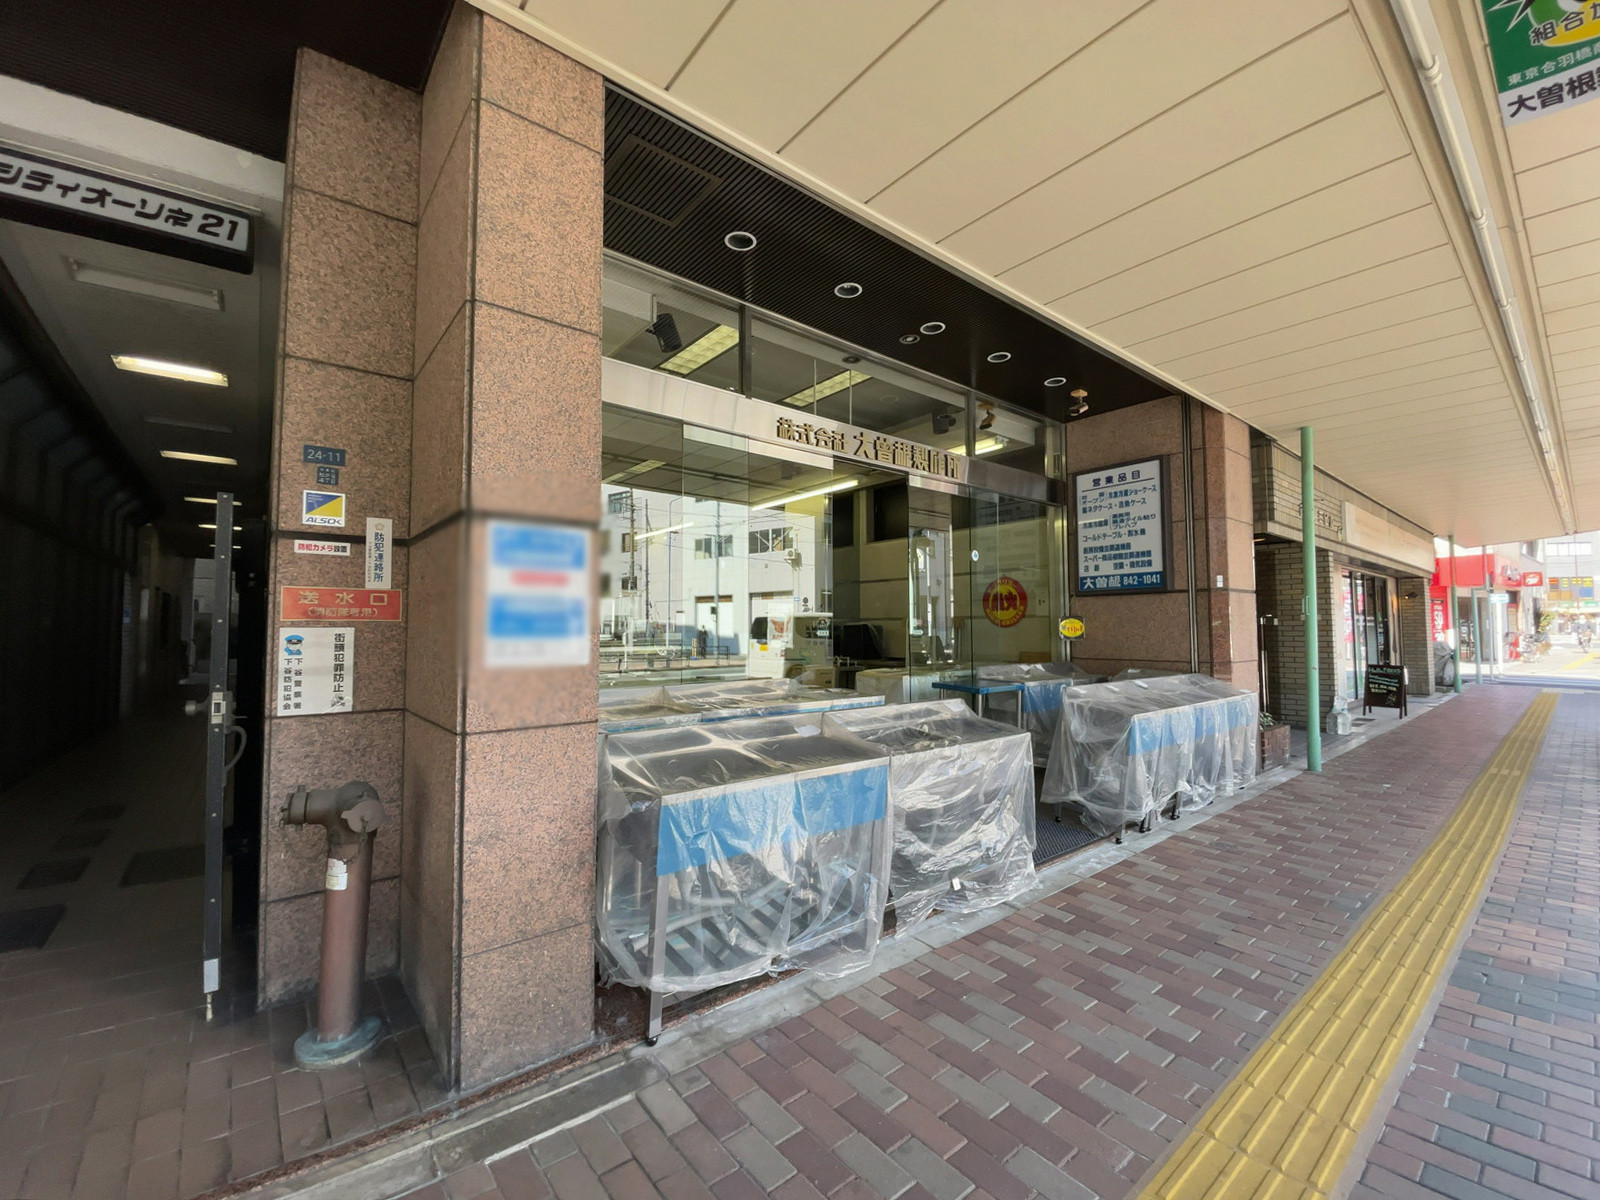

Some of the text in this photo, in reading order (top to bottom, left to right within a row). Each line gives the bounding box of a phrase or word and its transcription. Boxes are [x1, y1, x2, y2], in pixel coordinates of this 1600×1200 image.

[1507, 67, 1600, 118] 大曽根
[777, 417, 848, 453] 株式会社
[307, 449, 341, 462] 24-11
[1092, 470, 1141, 487] 営業品目
[305, 516, 342, 526] ALSOK
[298, 543, 348, 553] 防犯カメラ設置
[373, 532, 385, 583] 防犯連絡所
[1123, 574, 1161, 585] 842-1041
[298, 590, 388, 606] 送水口
